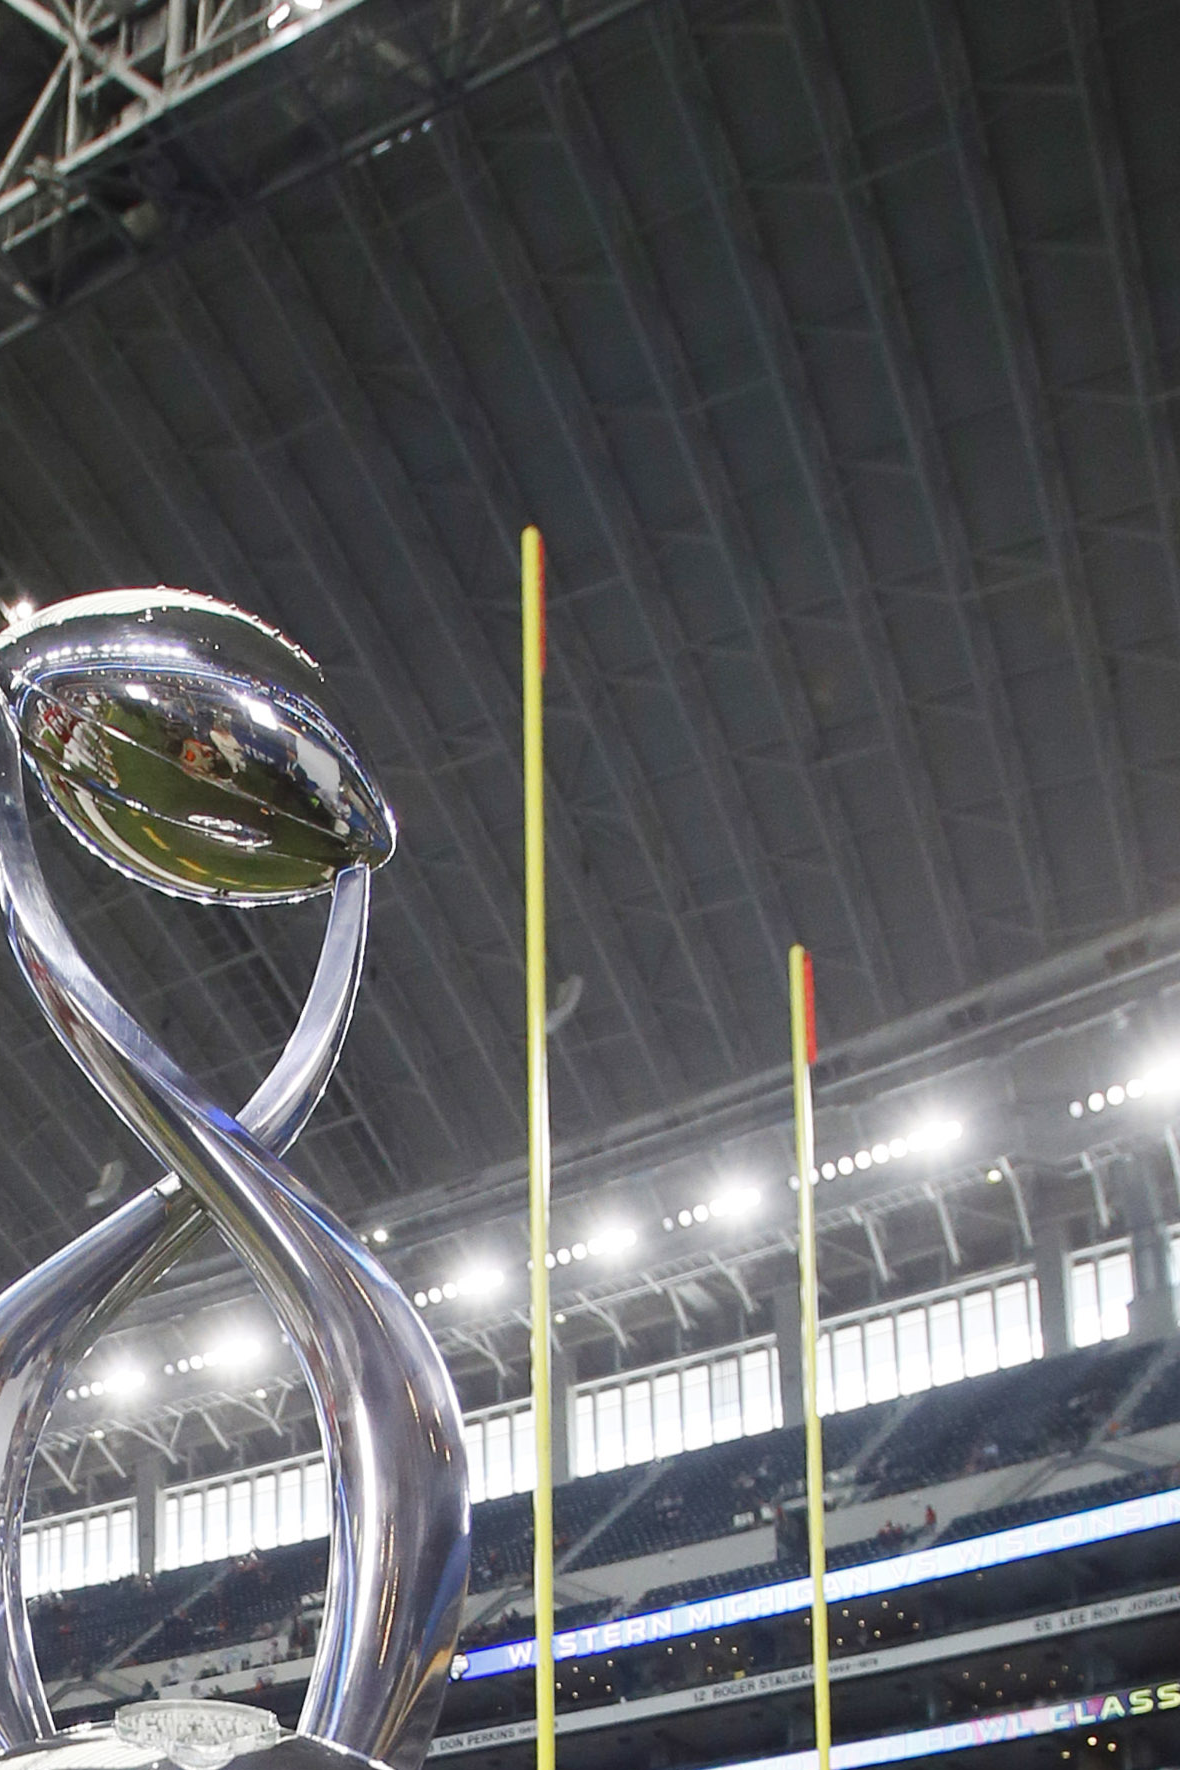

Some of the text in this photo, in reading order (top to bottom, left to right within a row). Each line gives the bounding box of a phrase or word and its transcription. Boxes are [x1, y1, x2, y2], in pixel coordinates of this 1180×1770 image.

[508, 1616, 673, 1666] WSTERN
[891, 1556, 937, 1580] VS
[759, 1668, 814, 1690] STAUBAC
[440, 1736, 463, 1751] DON
[467, 1727, 516, 1748] PERKINS
[928, 1715, 1028, 1747] BOWL
